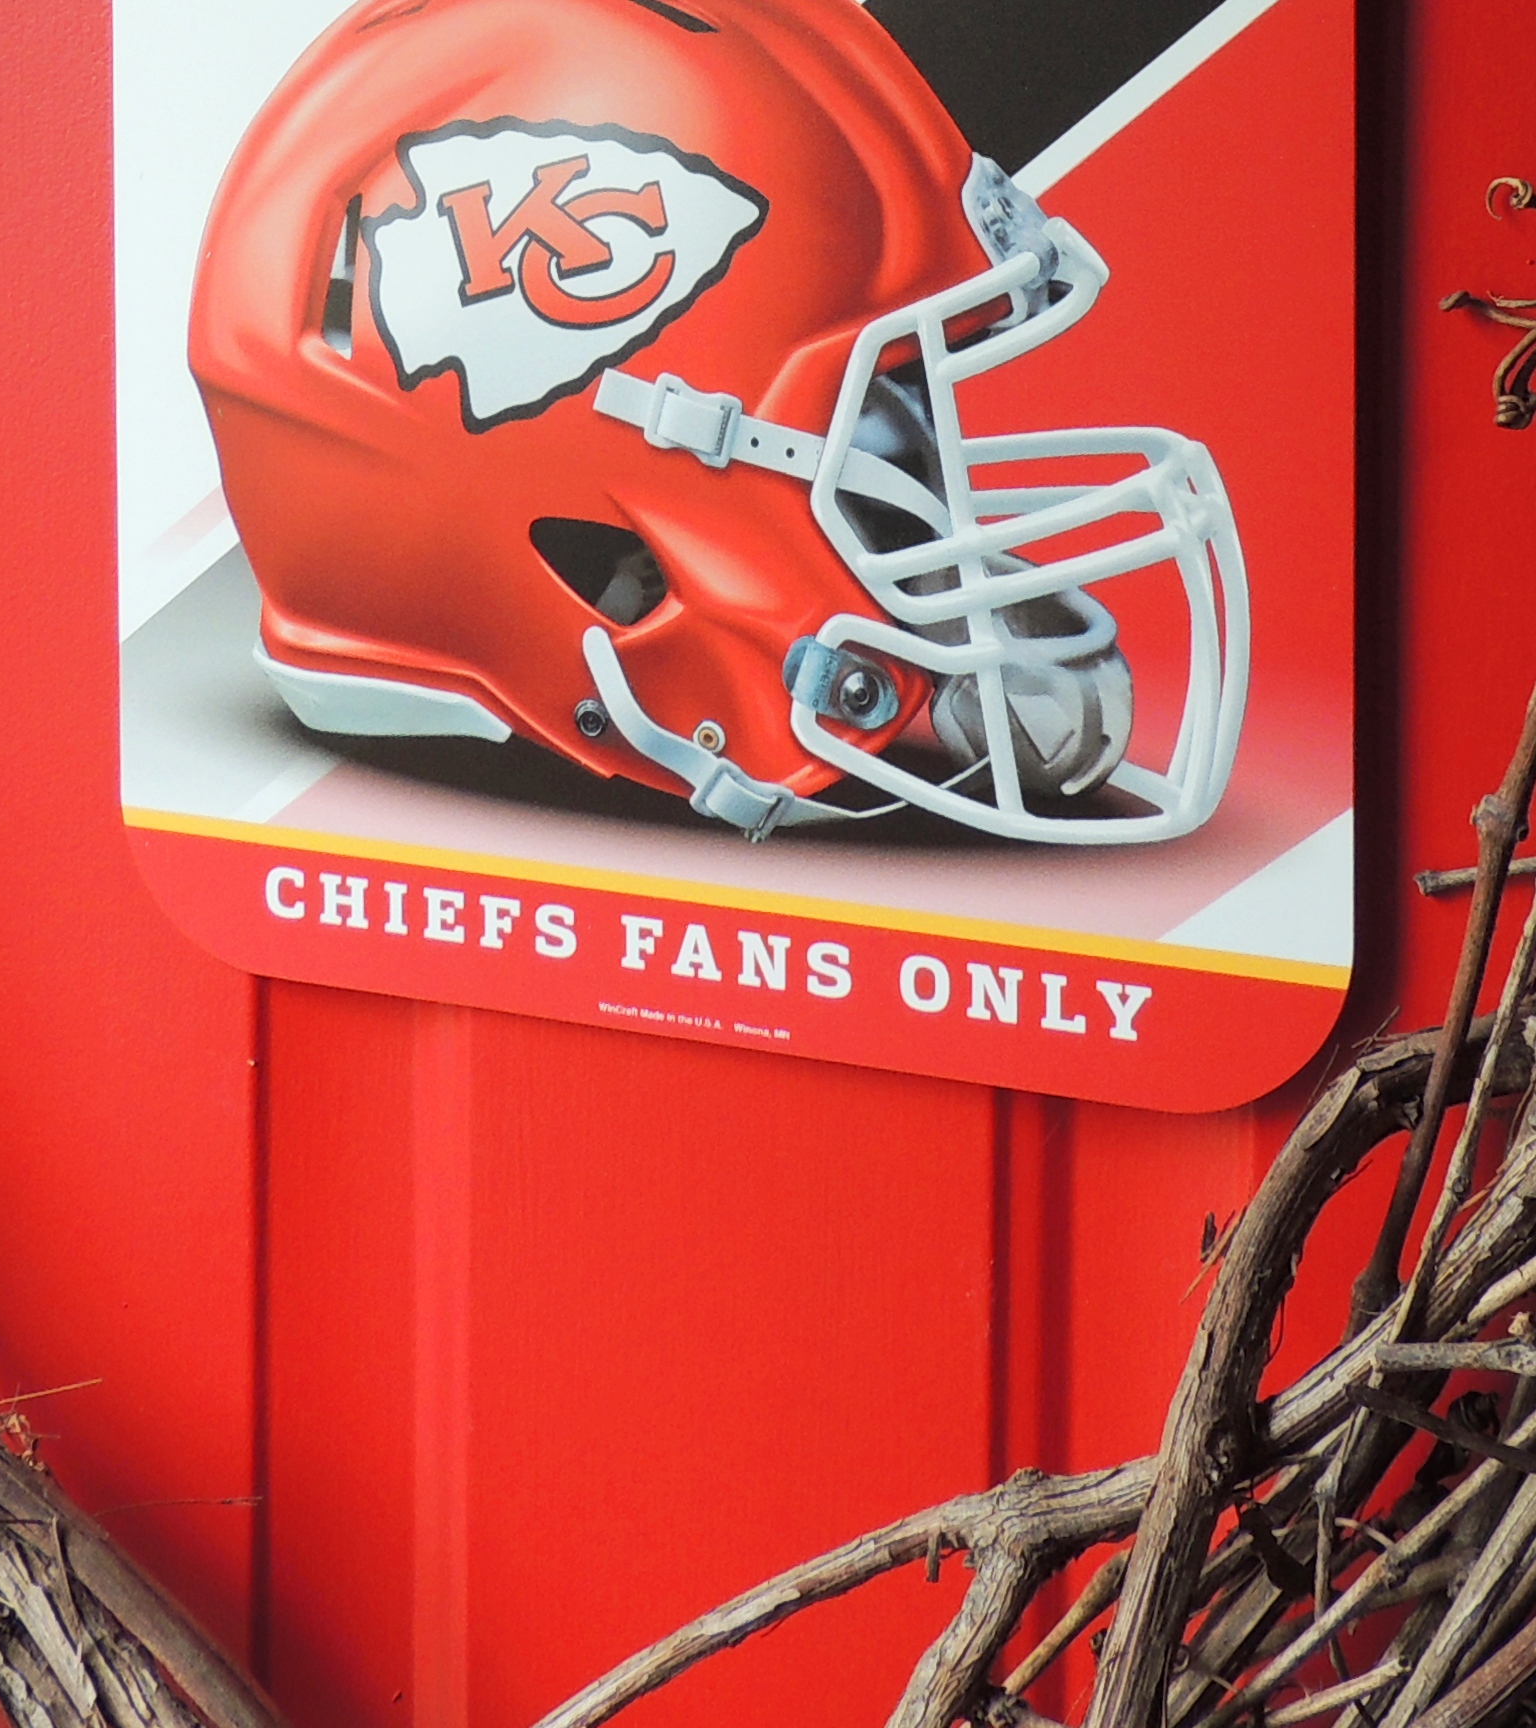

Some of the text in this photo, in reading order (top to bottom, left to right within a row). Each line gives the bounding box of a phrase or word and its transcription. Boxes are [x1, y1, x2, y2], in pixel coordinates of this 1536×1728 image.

[437, 154, 675, 330] KC
[263, 865, 1153, 1042] CHIEFS FANS ONLY
[598, 1002, 638, 1017] WinCraft
[640, 1008, 665, 1022] Made
[666, 1013, 676, 1023] in
[677, 1014, 693, 1025] the
